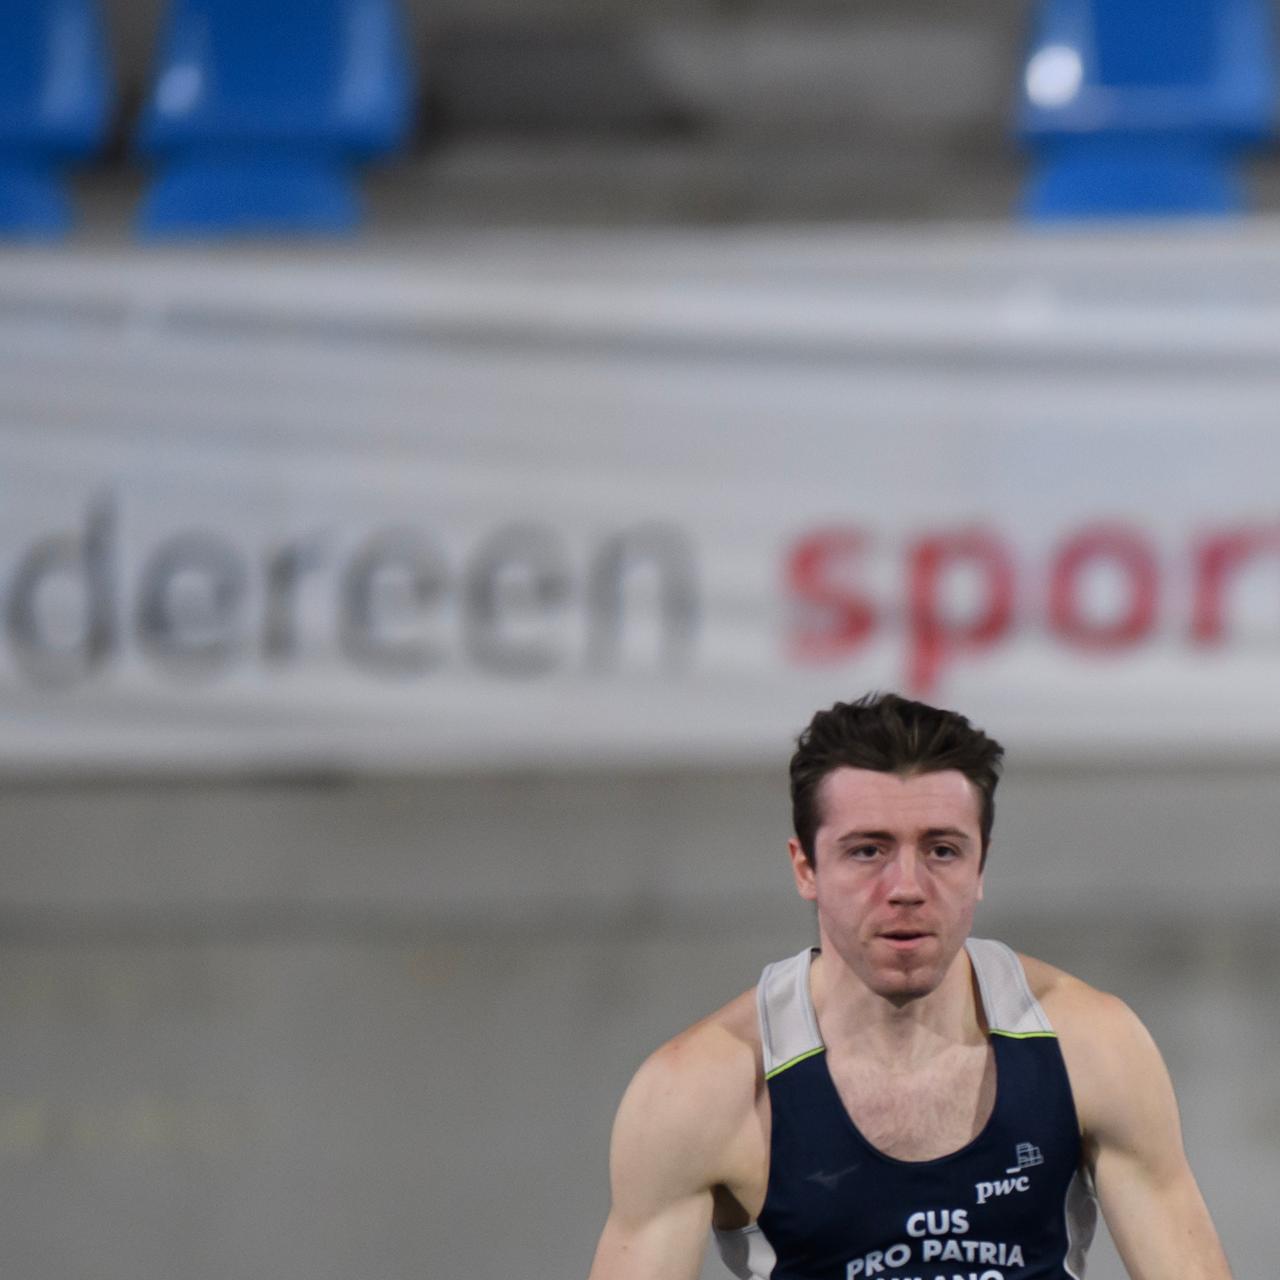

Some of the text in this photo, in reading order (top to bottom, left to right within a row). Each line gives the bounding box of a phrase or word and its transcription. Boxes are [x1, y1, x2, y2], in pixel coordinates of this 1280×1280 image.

[975, 1176, 1030, 1204] pwc
[906, 1209, 969, 1238] CUS
[923, 1239, 1025, 1268] PATRIA
